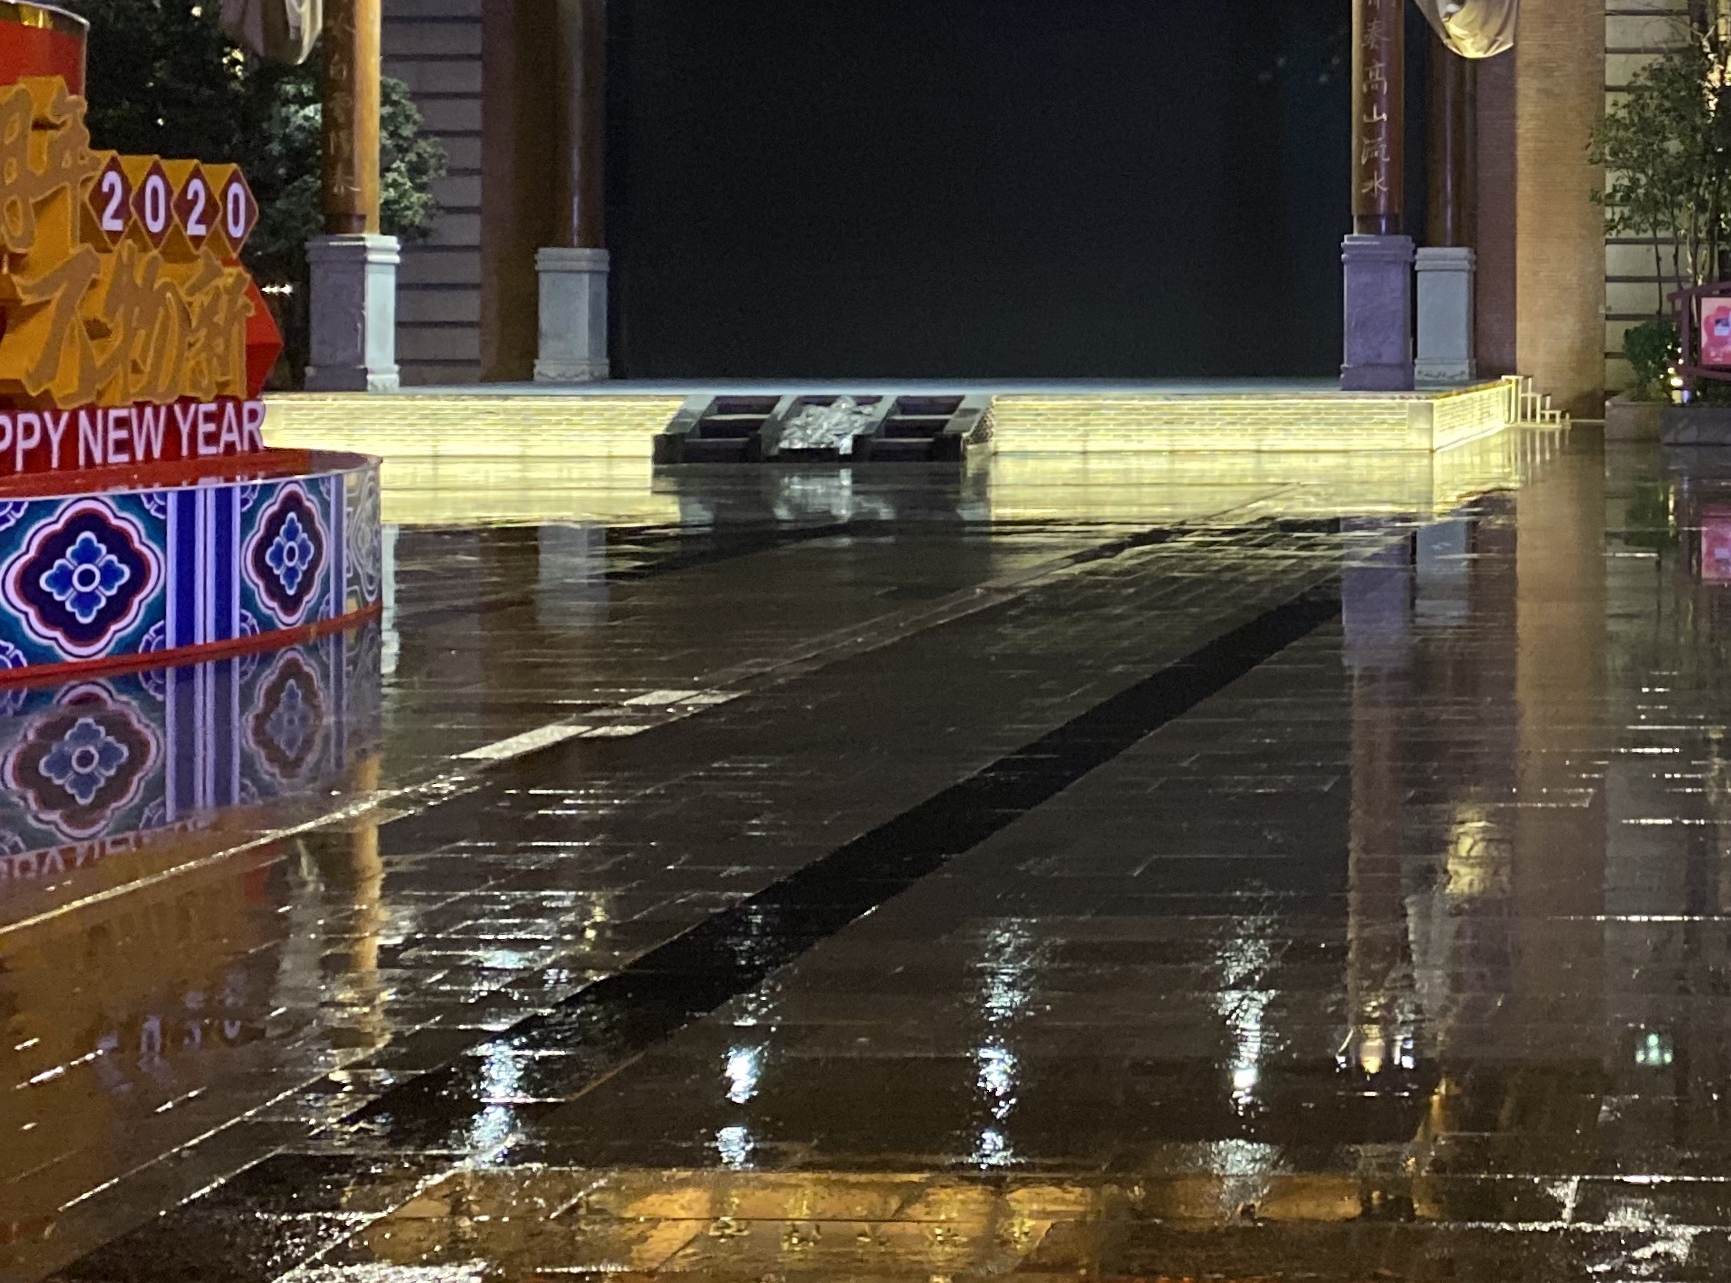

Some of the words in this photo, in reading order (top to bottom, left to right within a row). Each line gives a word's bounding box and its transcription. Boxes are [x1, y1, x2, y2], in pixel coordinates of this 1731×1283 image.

[101, 170, 246, 239] 2020
[78, 405, 167, 467] NEW
[173, 400, 266, 457] YEAR
